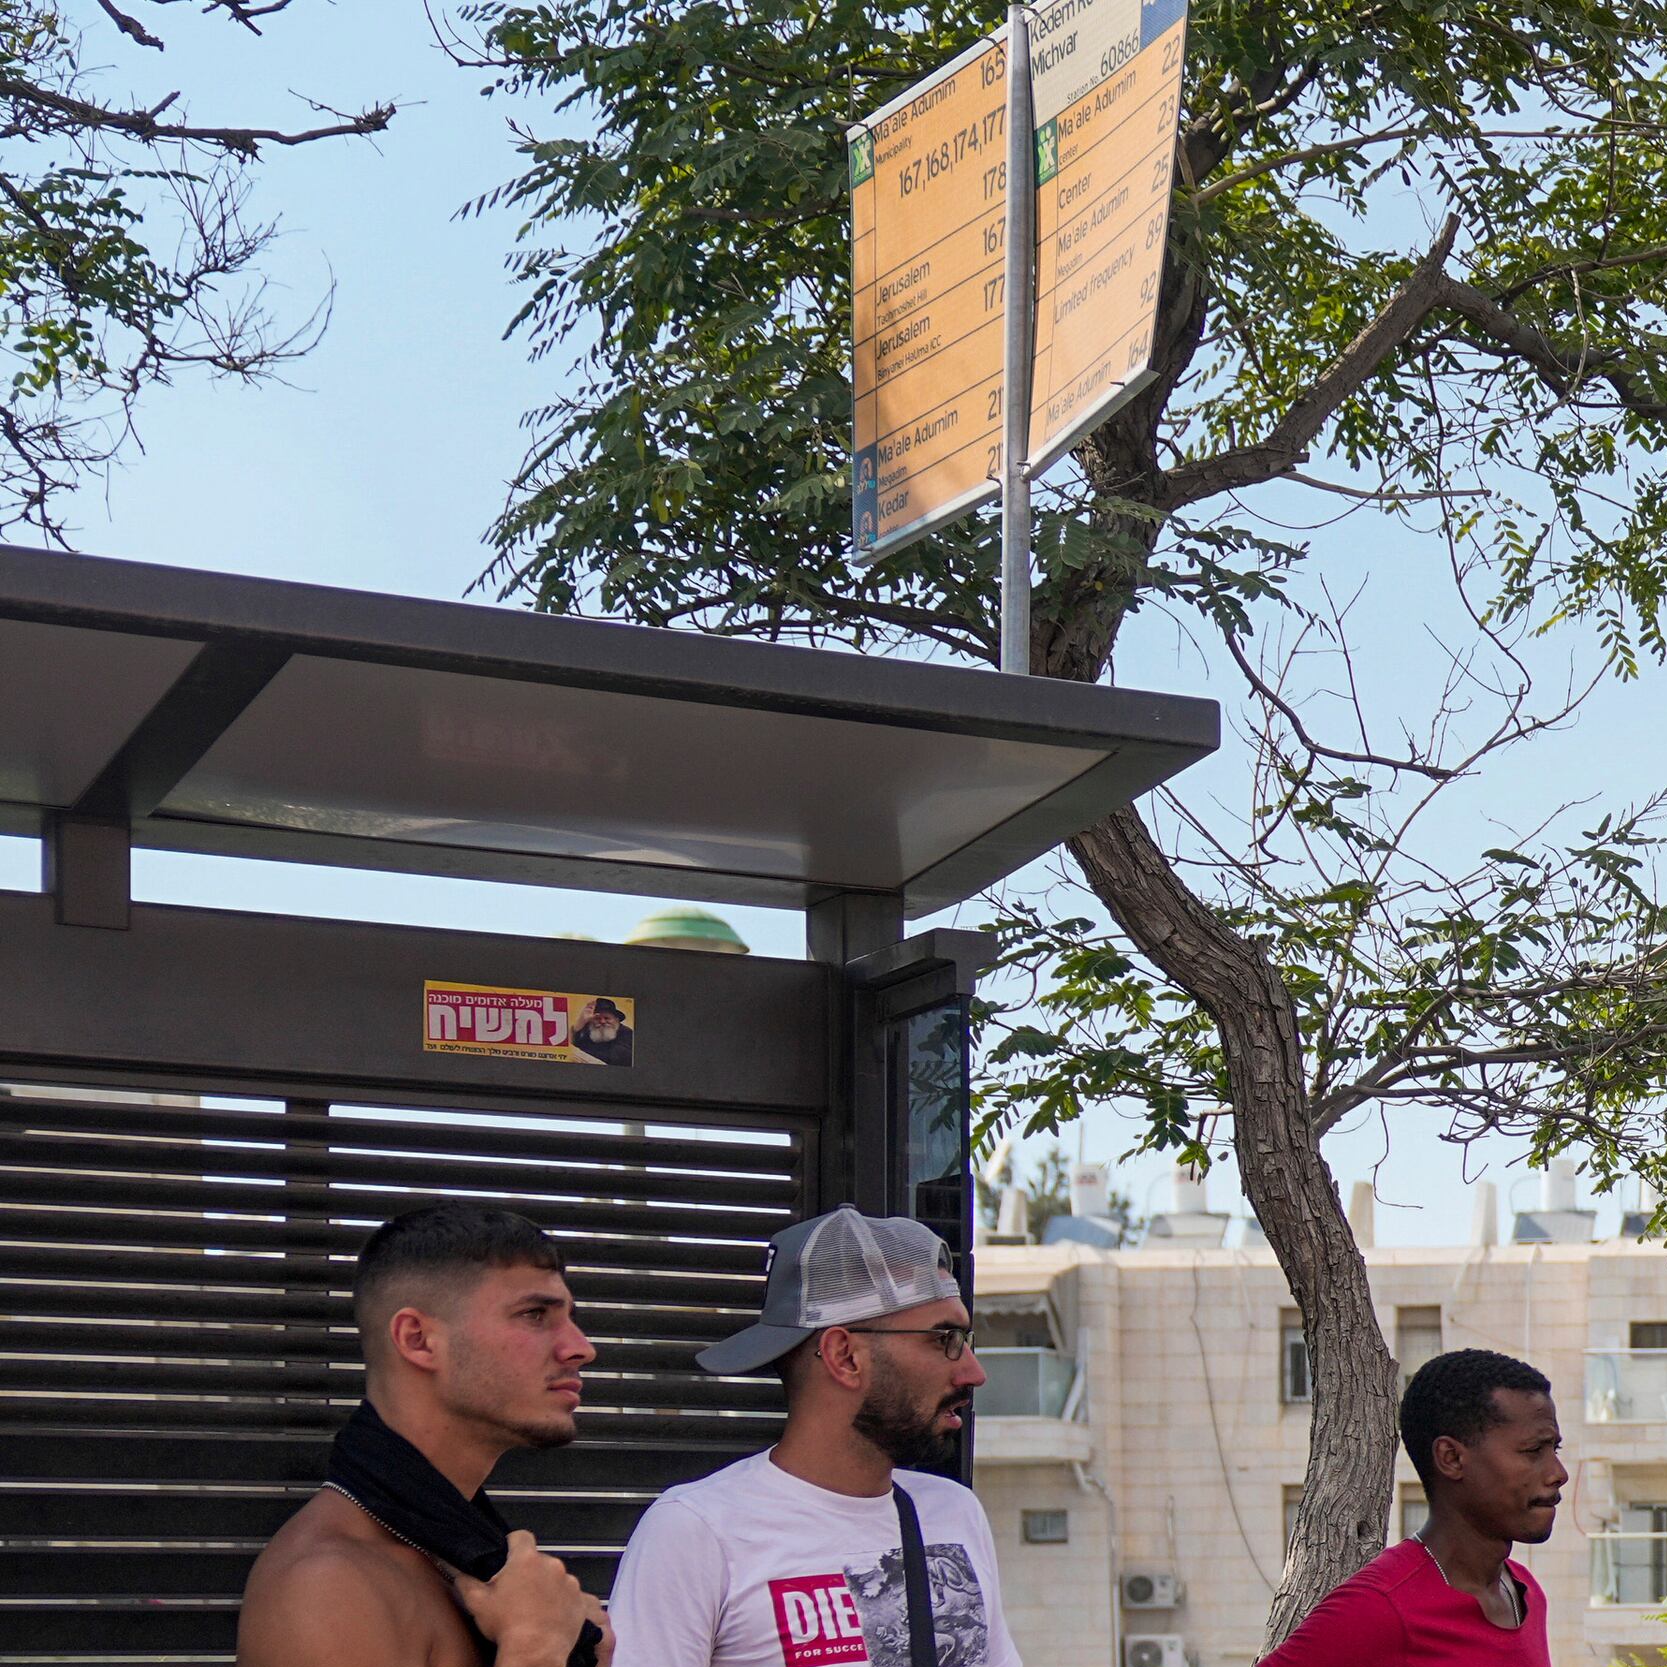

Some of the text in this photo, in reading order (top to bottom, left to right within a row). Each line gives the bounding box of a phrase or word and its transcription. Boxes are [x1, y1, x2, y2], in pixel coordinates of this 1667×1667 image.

[980, 51, 1005, 89] 165
[1032, 30, 1078, 80] Michvar
[1100, 28, 1139, 77] 60866
[911, 79, 956, 122] Adumim
[1058, 34, 1180, 142] Ma'ale Adumim 22
[1157, 94, 1175, 135] 23
[875, 135, 912, 165] Municipality
[983, 161, 1006, 200] 178
[1058, 152, 1169, 209] Center 25
[983, 215, 1005, 256] 167
[1090, 186, 1129, 231] Adumim
[1146, 212, 1164, 250] 89
[877, 260, 930, 306] Jerusalem
[984, 274, 1005, 312] 177
[1054, 243, 1136, 324] Limited frequency
[1140, 270, 1157, 308] 92
[877, 315, 930, 360] Jerusalem
[1076, 360, 1112, 405] Adumim
[1127, 328, 1149, 373] 164
[987, 385, 1003, 422] 21
[914, 409, 958, 448] Adumim
[987, 442, 1003, 475] 21
[878, 489, 909, 521] Kedar
[428, 993, 542, 1008] מעלה אדומים מוכנה
[428, 996, 569, 1046] למשיח
[795, 1644, 864, 1659] FOR SUCCE
